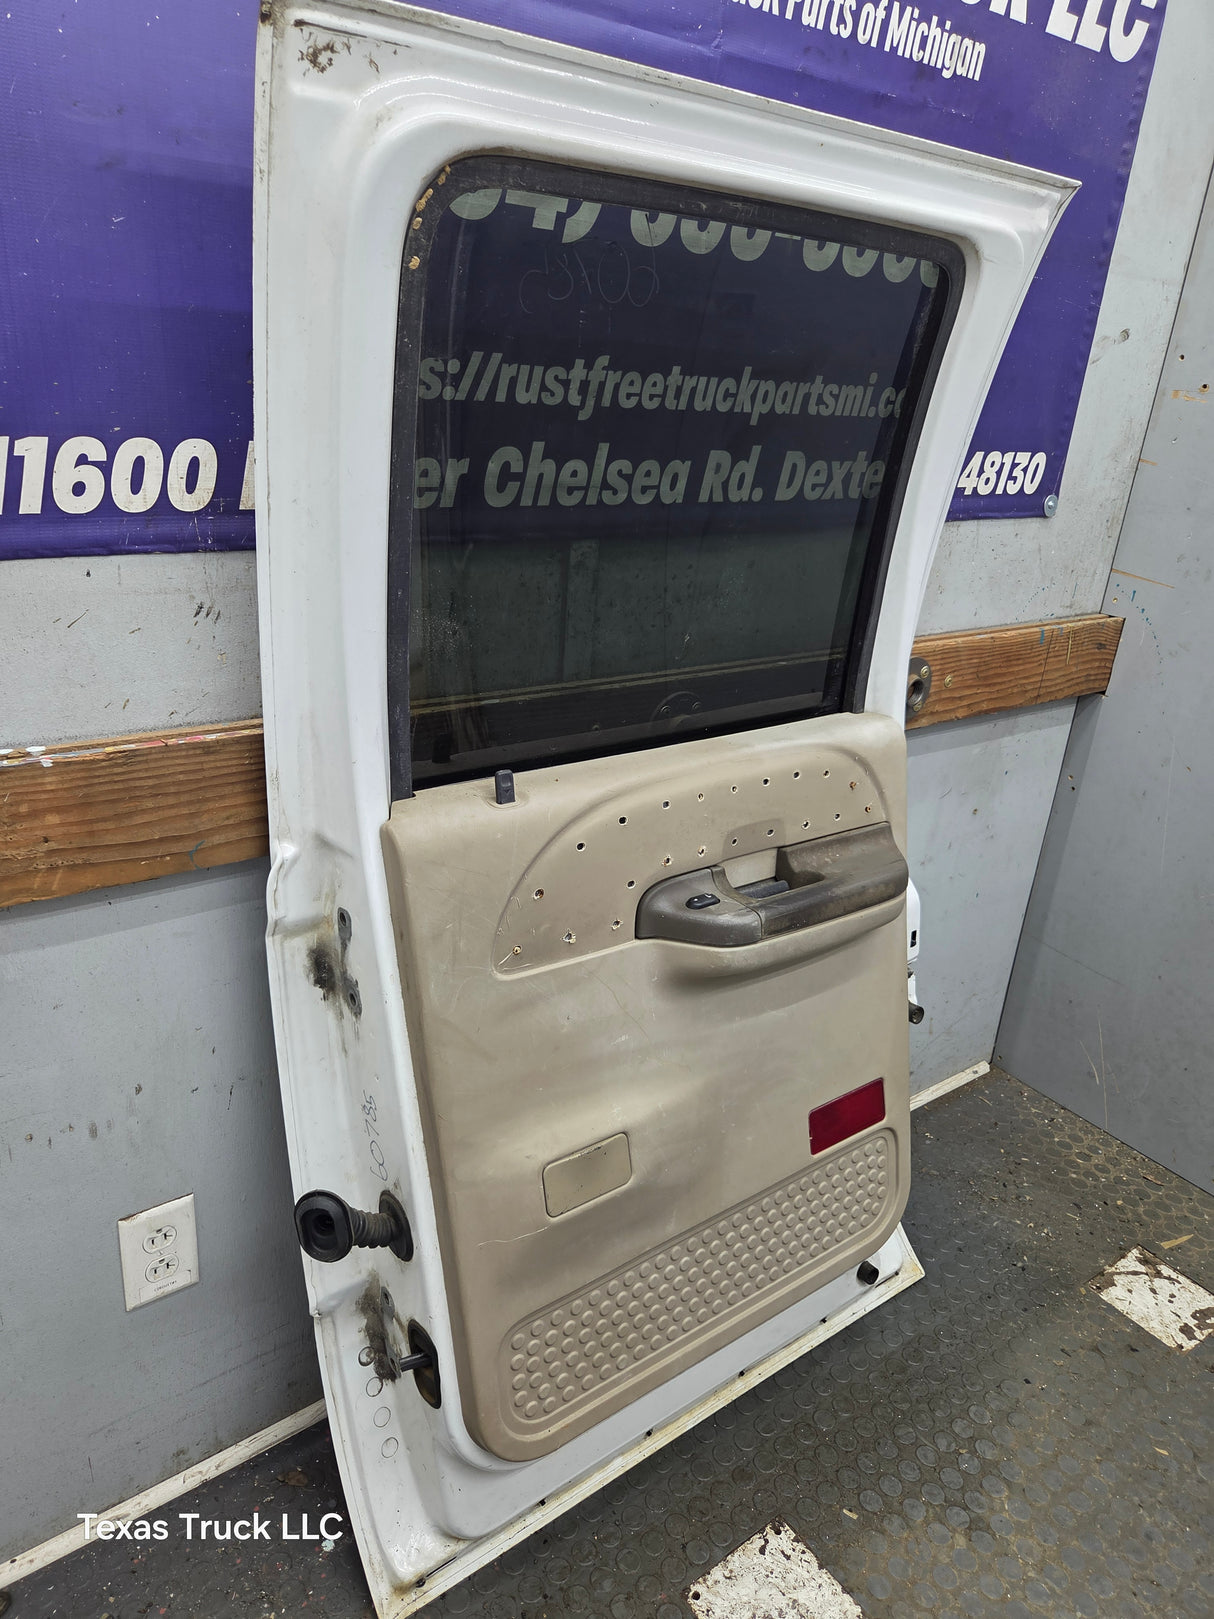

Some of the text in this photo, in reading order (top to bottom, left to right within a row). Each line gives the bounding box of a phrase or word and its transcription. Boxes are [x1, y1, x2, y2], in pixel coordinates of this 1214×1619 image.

[857, 0, 889, 48] of
[884, 1, 986, 81] Michigan
[0, 435, 218, 515] 1600
[483, 441, 692, 508] Chelsea
[698, 445, 763, 504] Rd.
[774, 450, 886, 501] Dexte
[957, 451, 1047, 496] 48130
